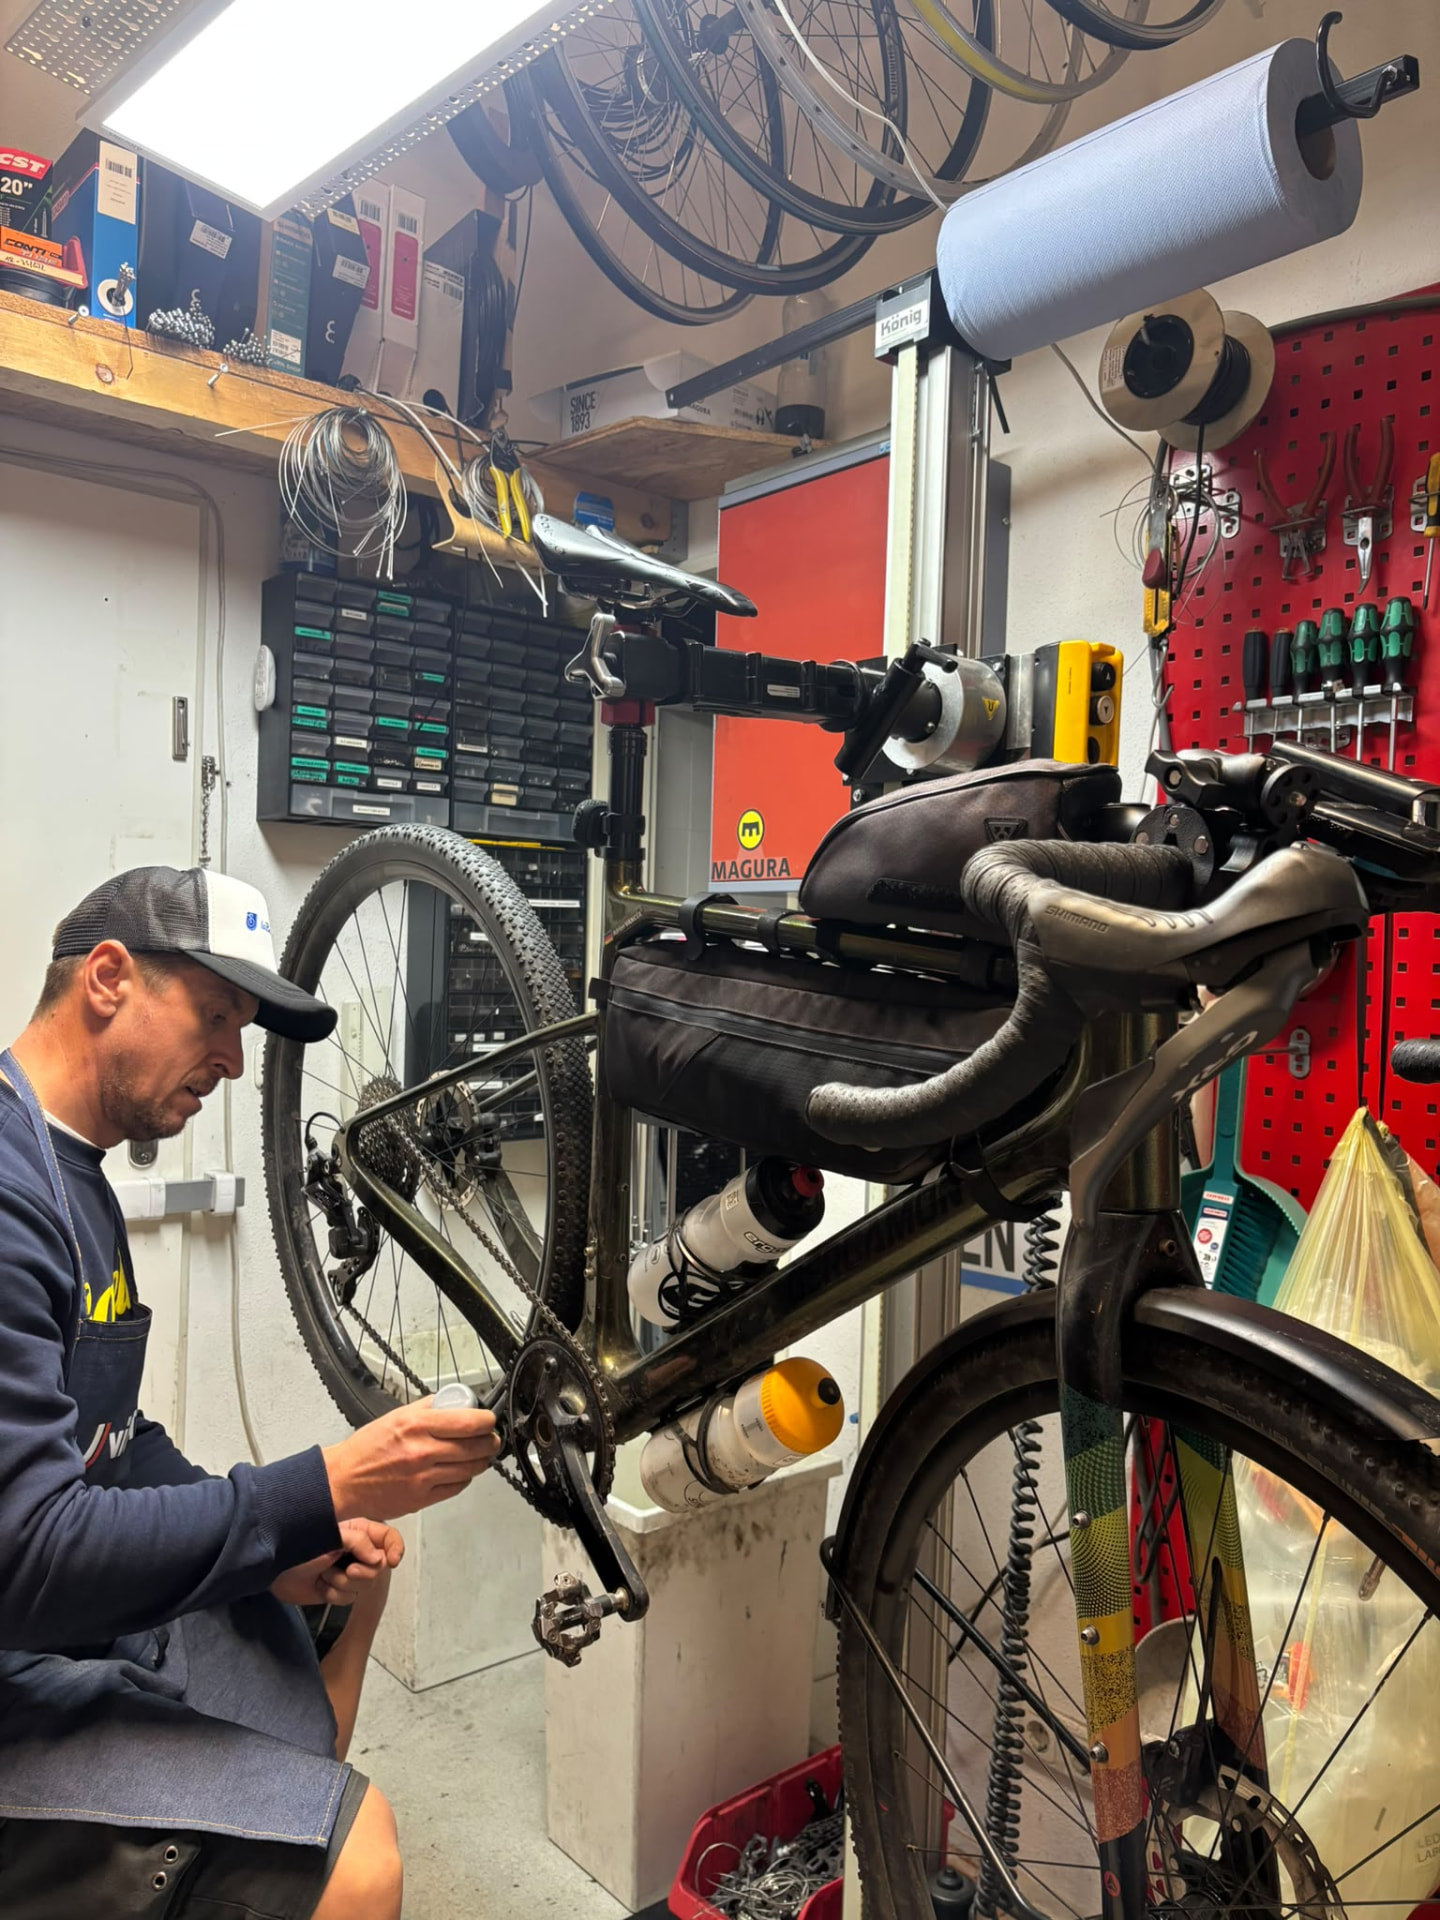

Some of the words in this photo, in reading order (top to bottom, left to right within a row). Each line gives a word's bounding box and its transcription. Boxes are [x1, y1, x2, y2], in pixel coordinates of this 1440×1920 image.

[0, 153, 46, 174] CST
[881, 308, 922, 337] König
[570, 391, 597, 415] SINCE
[689, 402, 711, 417] AGURA
[570, 411, 591, 433] 1893
[712, 858, 791, 880] MAGURA
[1045, 904, 1110, 934] SHIMANO
[961, 1221, 1015, 1273] N
